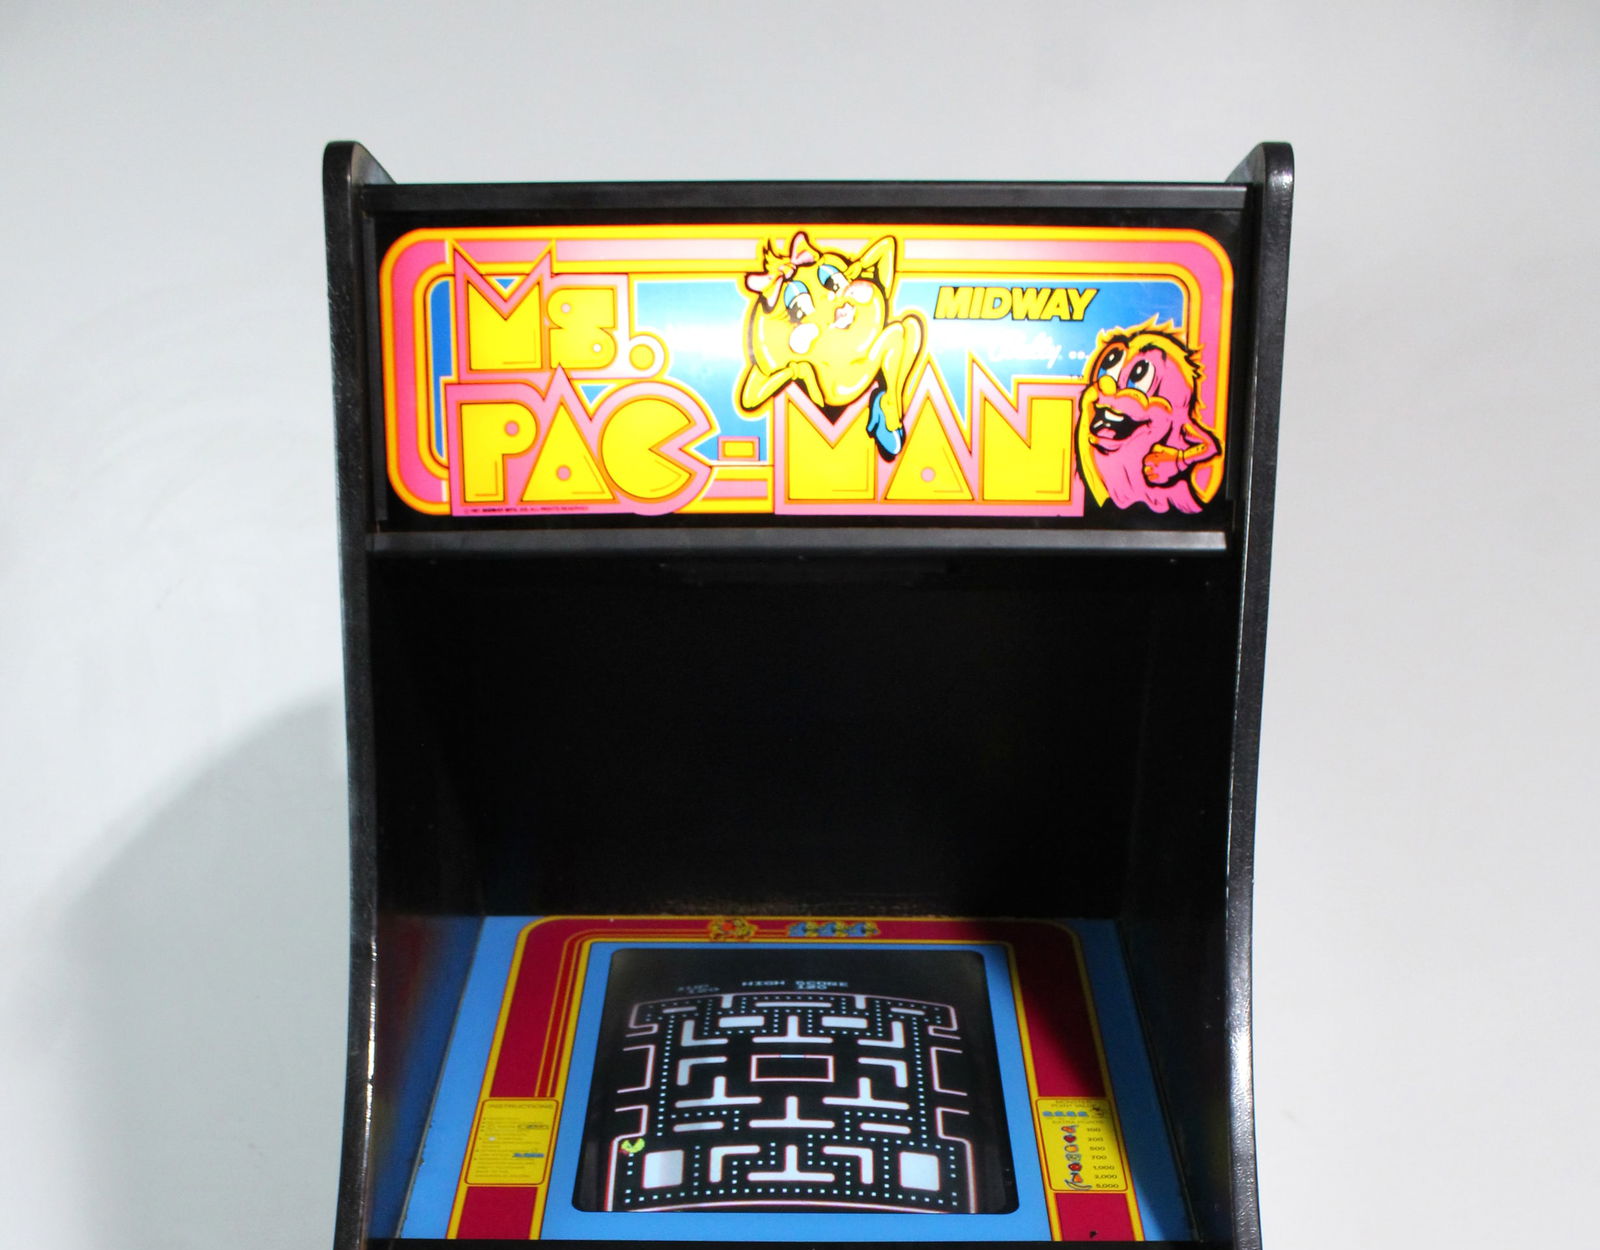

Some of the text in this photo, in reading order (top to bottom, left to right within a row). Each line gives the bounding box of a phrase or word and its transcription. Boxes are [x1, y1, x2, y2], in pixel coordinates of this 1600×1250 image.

[460, 262, 660, 376] MS.
[934, 286, 1099, 321] MIDWAY
[454, 380, 1078, 508] PAC-MAN
